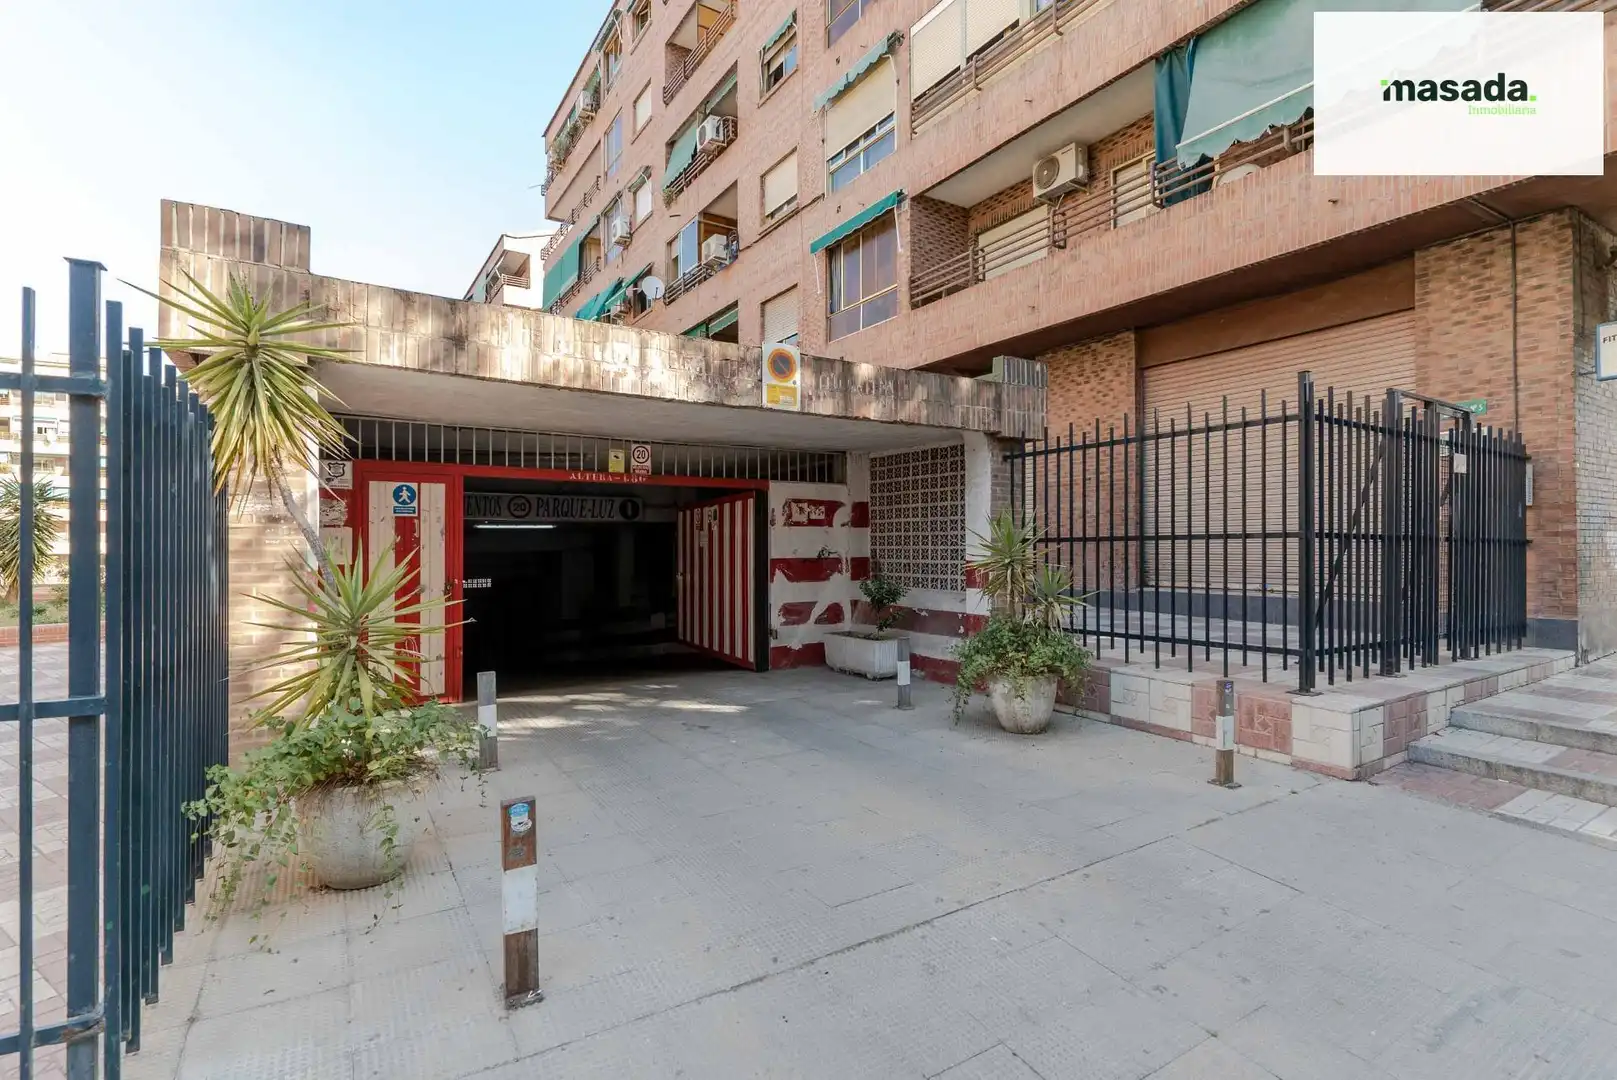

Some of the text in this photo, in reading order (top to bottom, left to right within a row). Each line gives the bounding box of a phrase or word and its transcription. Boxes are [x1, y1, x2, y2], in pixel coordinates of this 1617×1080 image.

[636, 449, 646, 460] 20
[513, 502, 527, 512] 20
[536, 496, 616, 519] PARQUE-LUZ
